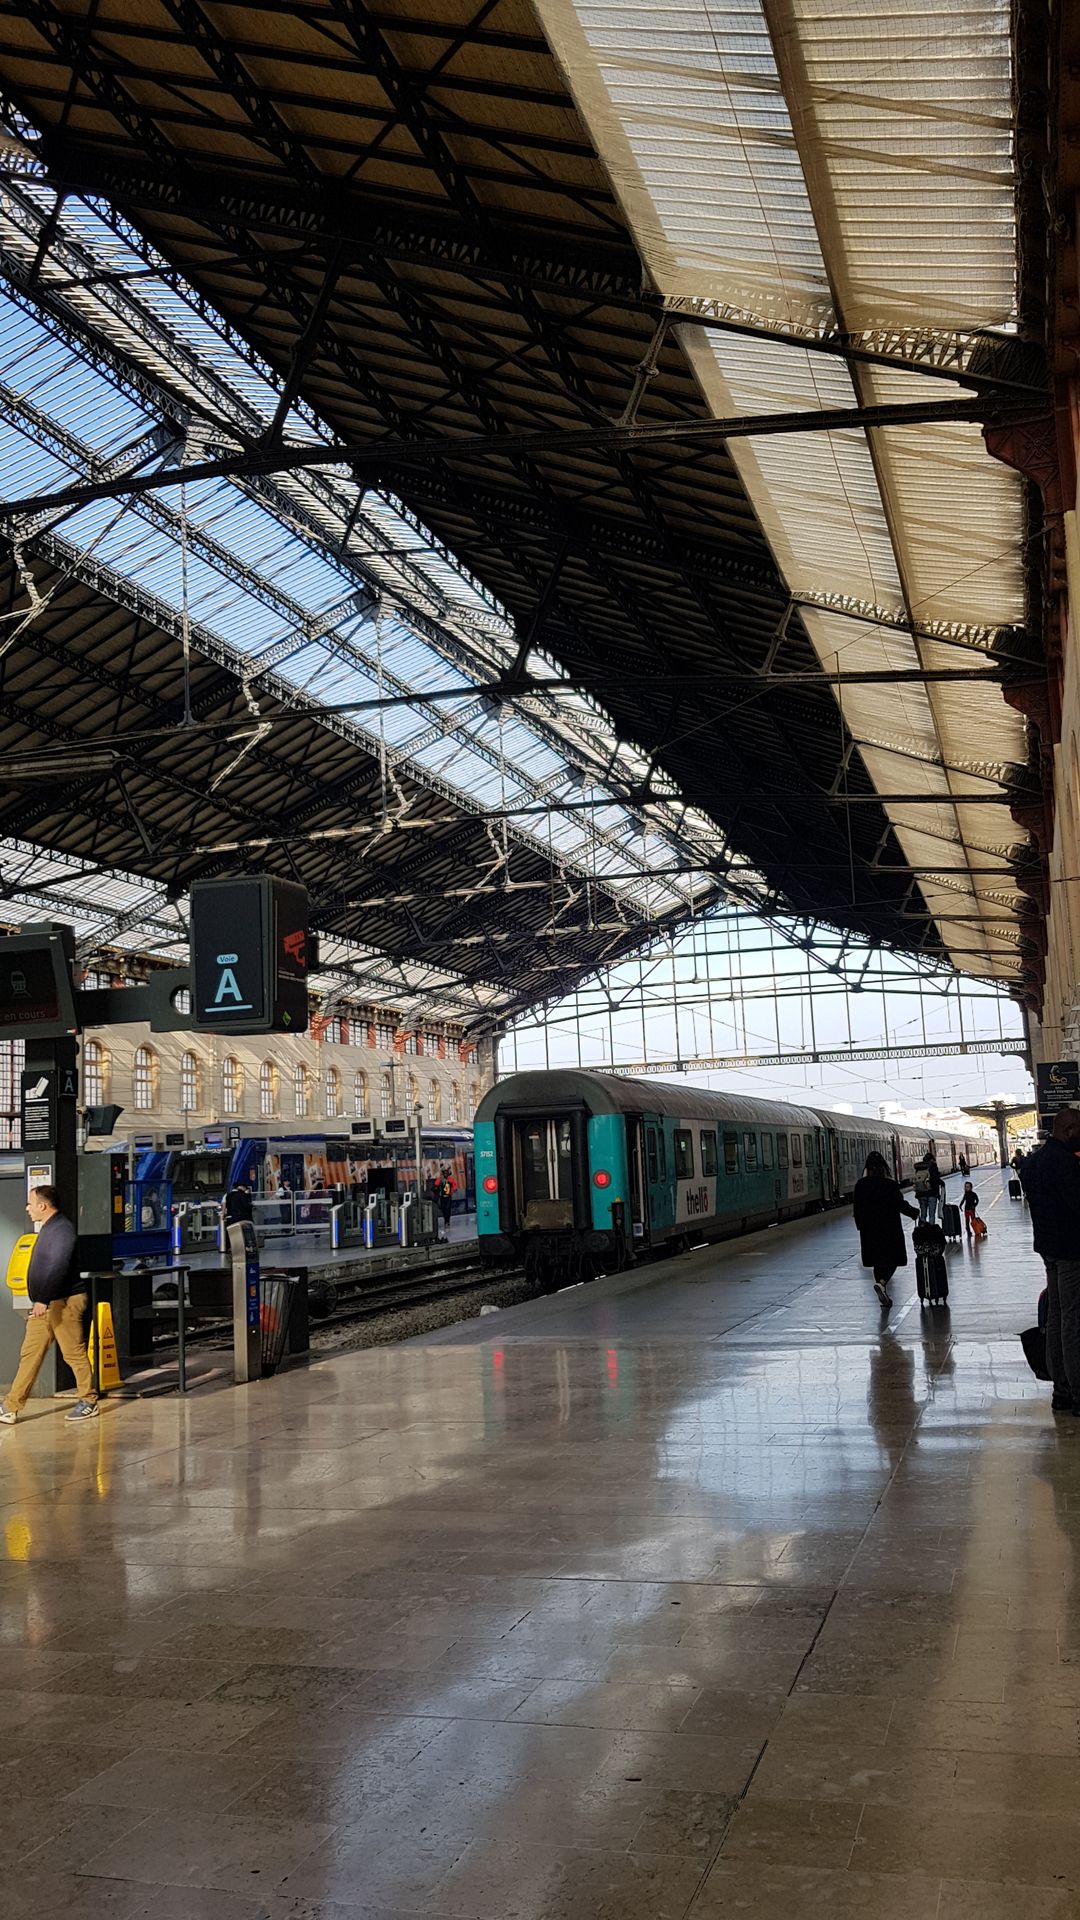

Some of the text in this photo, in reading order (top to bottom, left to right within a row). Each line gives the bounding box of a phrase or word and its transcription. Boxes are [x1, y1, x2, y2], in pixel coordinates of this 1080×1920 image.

[214, 968, 243, 1003] A
[4, 1010, 46, 1021] en cours
[64, 1076, 74, 1093] A
